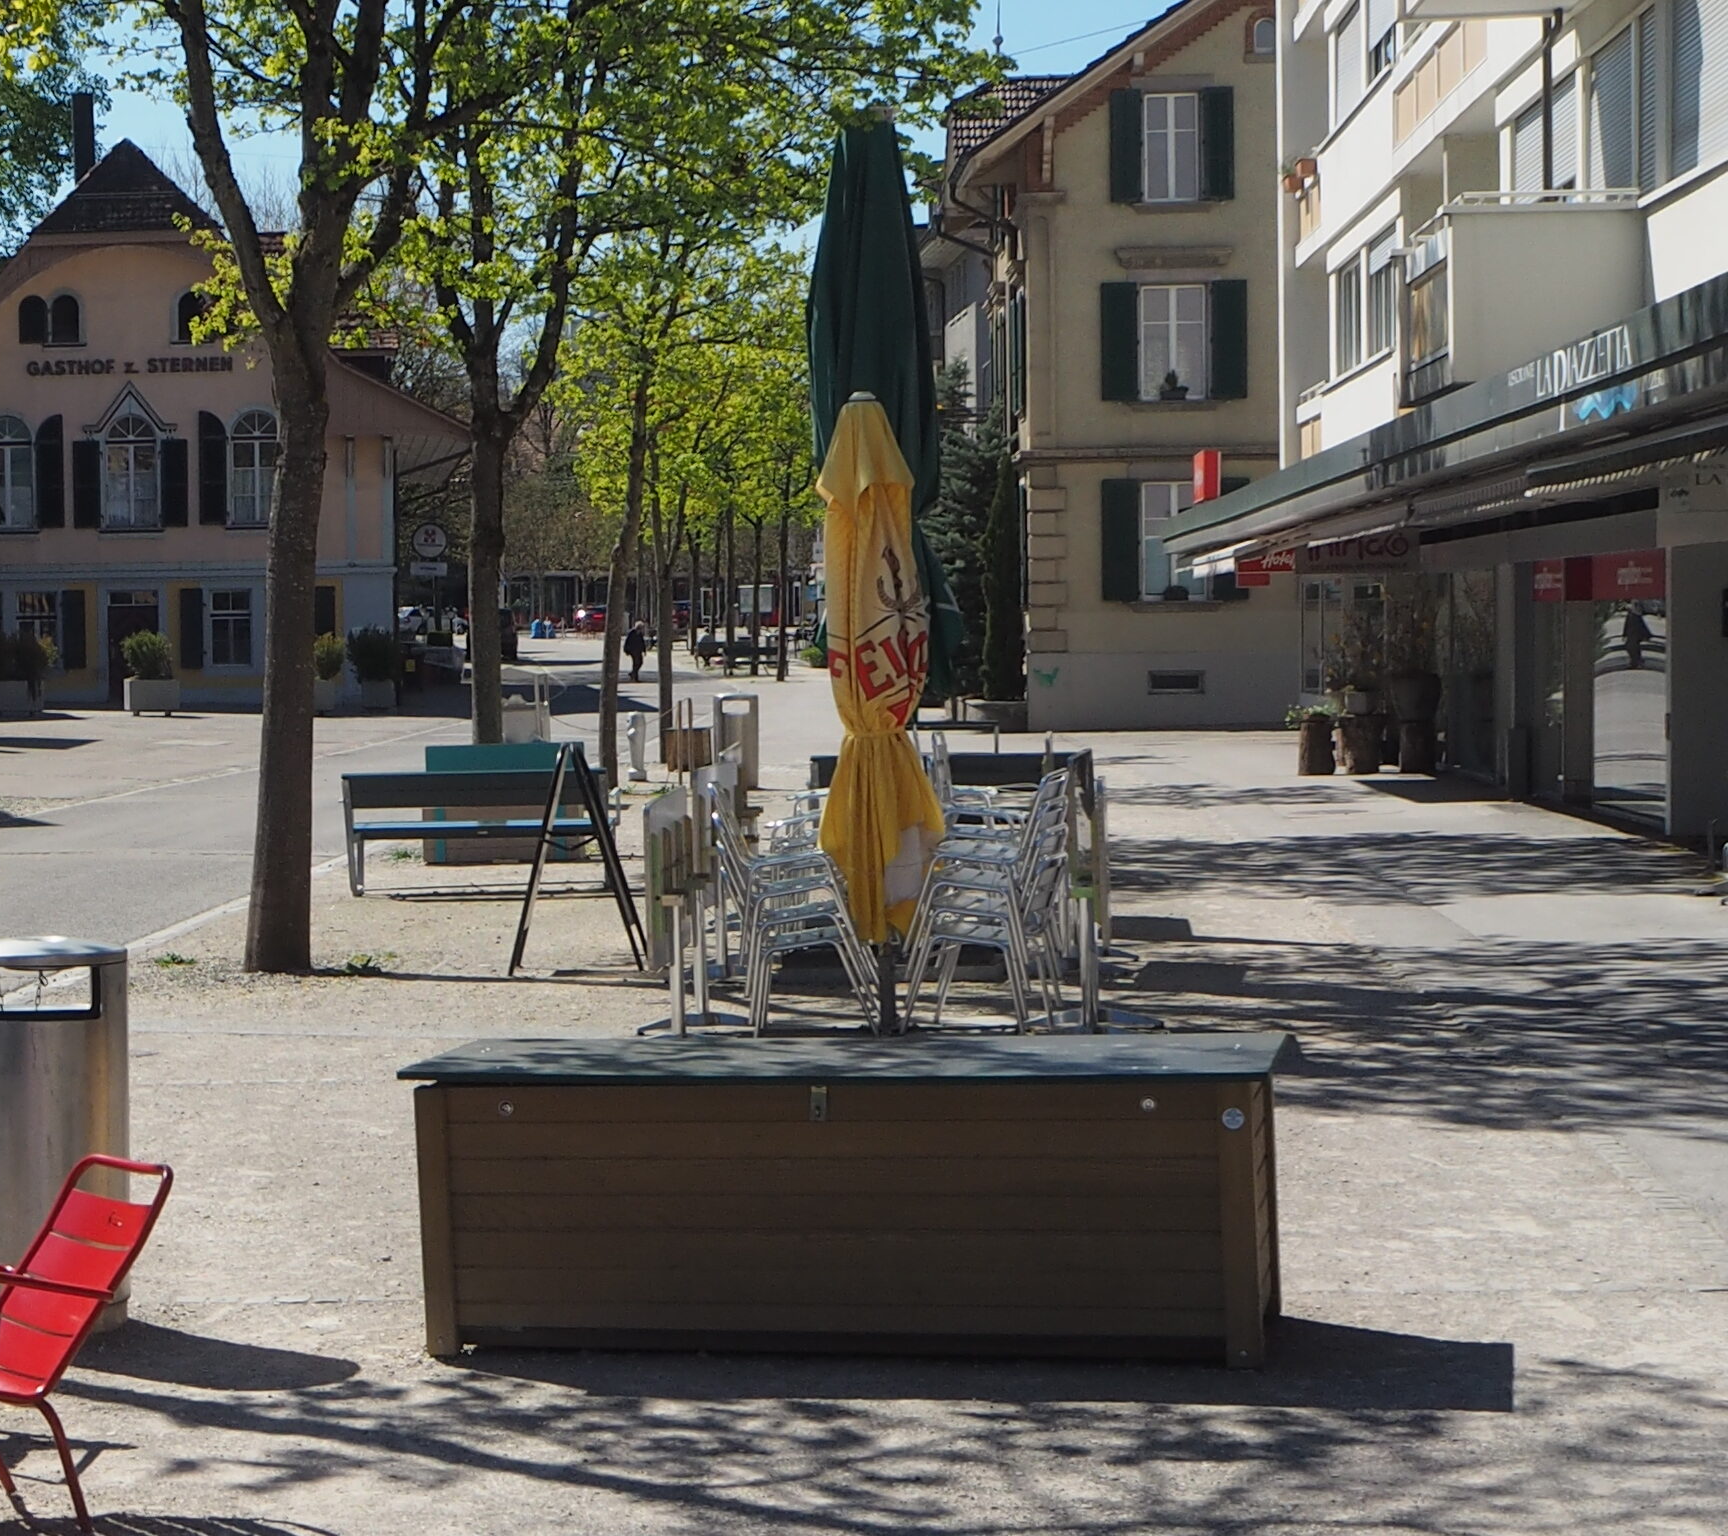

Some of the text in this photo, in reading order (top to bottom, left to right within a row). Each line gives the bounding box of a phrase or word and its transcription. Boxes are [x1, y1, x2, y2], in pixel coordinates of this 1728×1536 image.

[26, 359, 115, 376] GASTHOF
[147, 356, 232, 374] STERNEN
[1536, 356, 1552, 398] LA
[1553, 324, 1632, 400] PIAZZETTA
